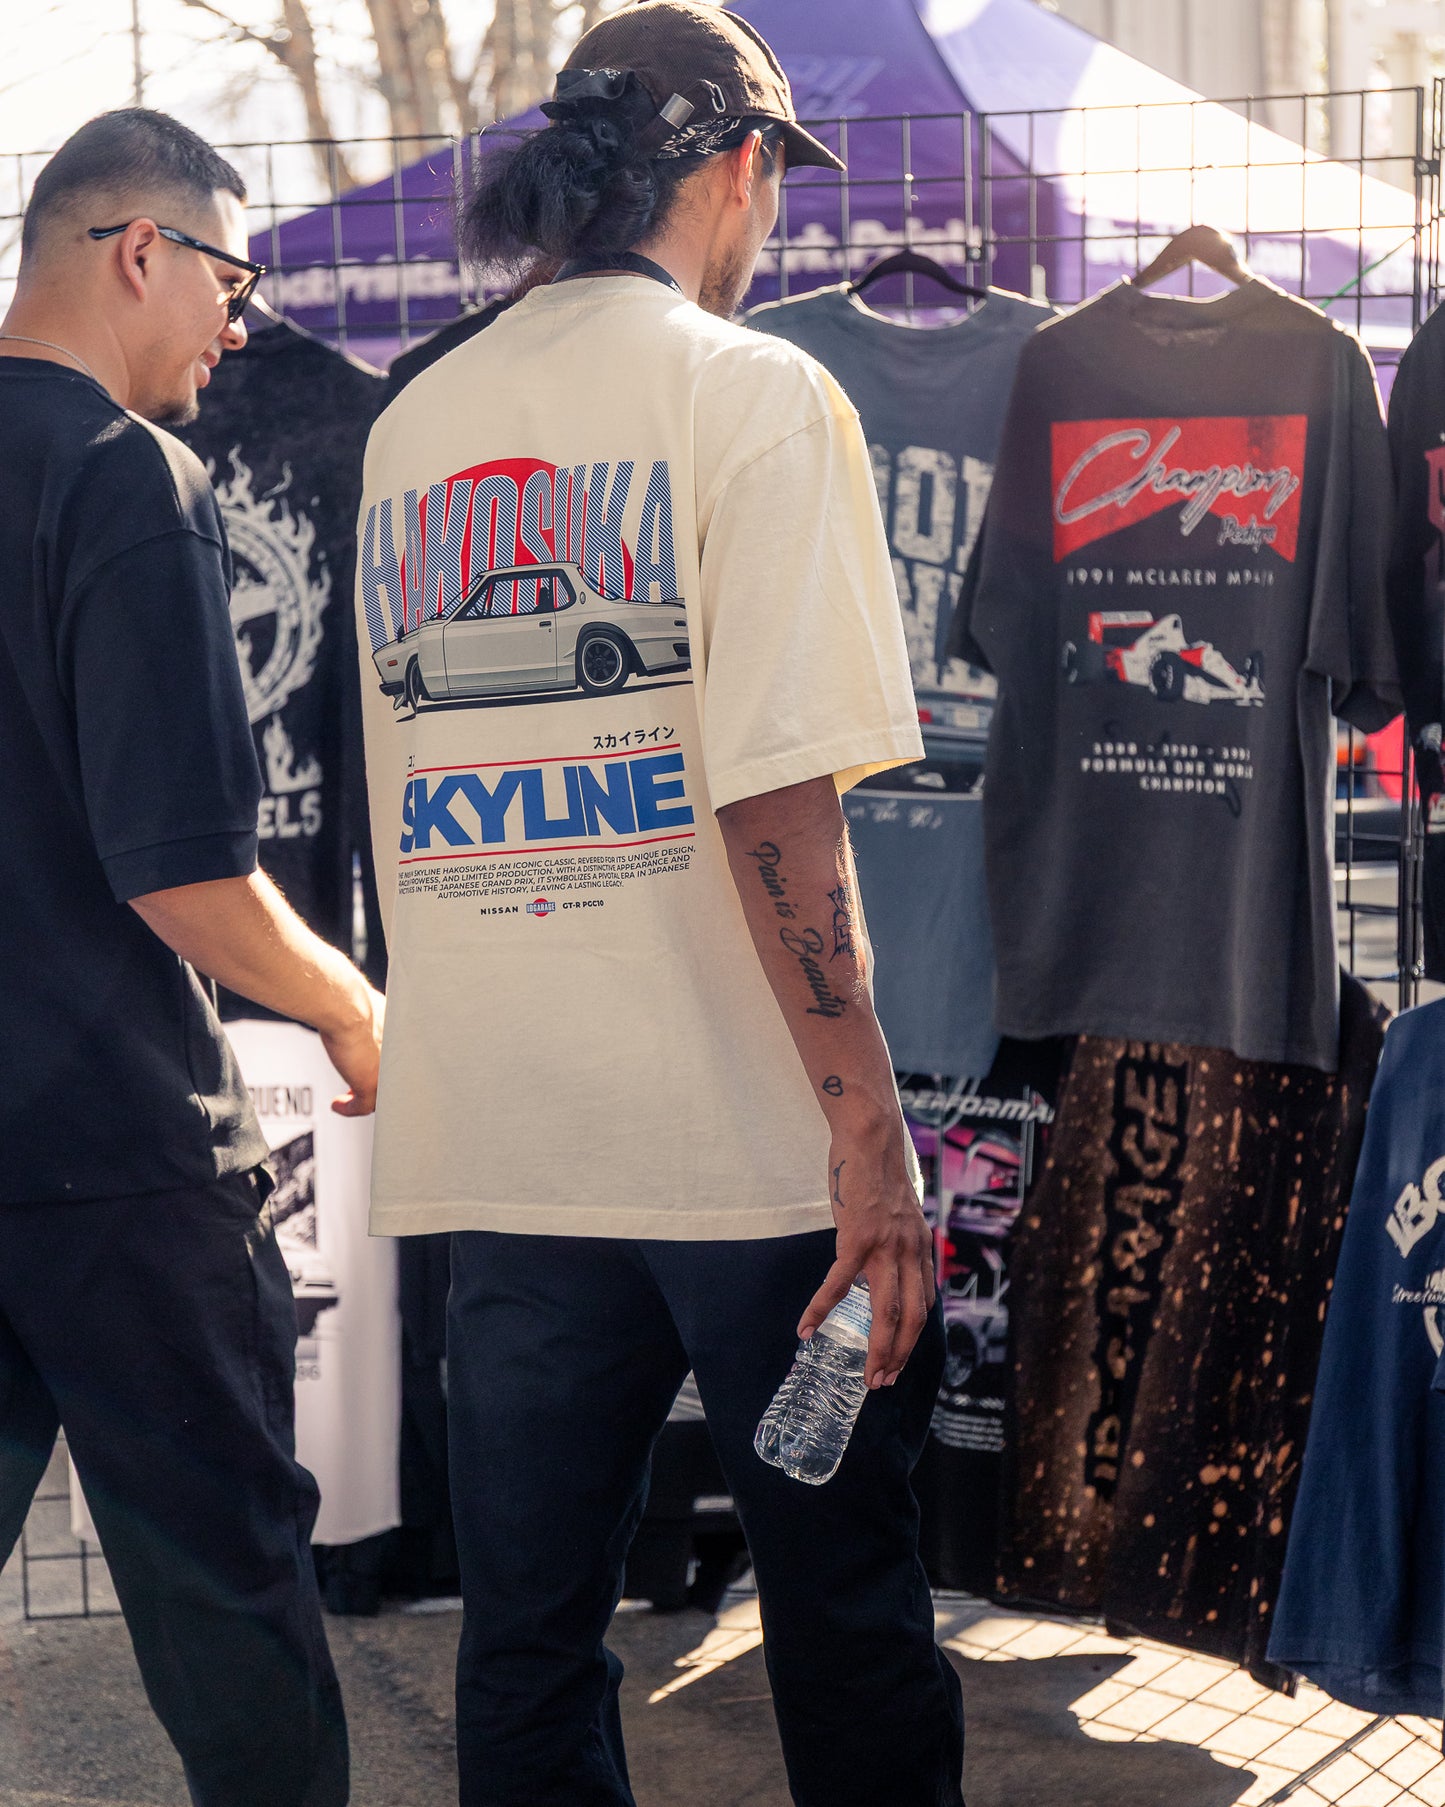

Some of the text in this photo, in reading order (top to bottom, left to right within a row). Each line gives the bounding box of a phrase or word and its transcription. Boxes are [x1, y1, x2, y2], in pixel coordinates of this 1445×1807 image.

[1056, 425, 1300, 537] Champion
[361, 459, 679, 654] HAKOSUKA
[1066, 567, 1114, 586] 1991
[1125, 568, 1217, 586] MCLAREN
[593, 725, 676, 750] スカイライン
[1080, 757, 1168, 774] FORMULA
[1172, 759, 1206, 777] ONE
[1138, 775, 1226, 795] CHAMPION
[400, 752, 695, 853] SKYLINE
[414, 867, 441, 878] SKYLINE
[442, 864, 487, 875] HAKOSUKA
[488, 863, 497, 872] IS
[499, 862, 511, 871] AN
[513, 860, 542, 869] ICONIC
[543, 857, 577, 867] CLASSIC,
[577, 855, 605, 865] REVERED
[605, 855, 616, 864] FOR
[616, 855, 626, 863] ITS
[627, 851, 660, 863] UNIQUE
[661, 844, 697, 857] DESIGN,
[442, 874, 460, 883] AND
[461, 871, 495, 882] LIMITED
[556, 865, 576, 874] WITH
[576, 865, 582, 873] A
[583, 863, 616, 873] DISTINCTIVE
[616, 859, 669, 871] APPEARANCE
[670, 853, 691, 865] AND
[415, 885, 422, 893] IN
[424, 884, 438, 892] THE
[439, 880, 480, 892] JAPANESE
[481, 878, 512, 888] GRAND
[514, 876, 536, 886] PRIX,
[537, 876, 546, 885] IT
[546, 873, 591, 884] SYMBOLIZES
[598, 871, 620, 880] PIVOTAL
[620, 871, 636, 881] ERA
[637, 869, 647, 878] IN
[647, 862, 690, 876] JAPANESE
[437, 879, 625, 900] AUTOMOTIVE HISTORY, LEAVING A LASTING LEGACY.
[480, 905, 519, 915] NISSAN
[562, 901, 581, 910] GT-R
[744, 840, 848, 1019] Pain is Beauty
[900, 1087, 1055, 1125] PERFORMA
